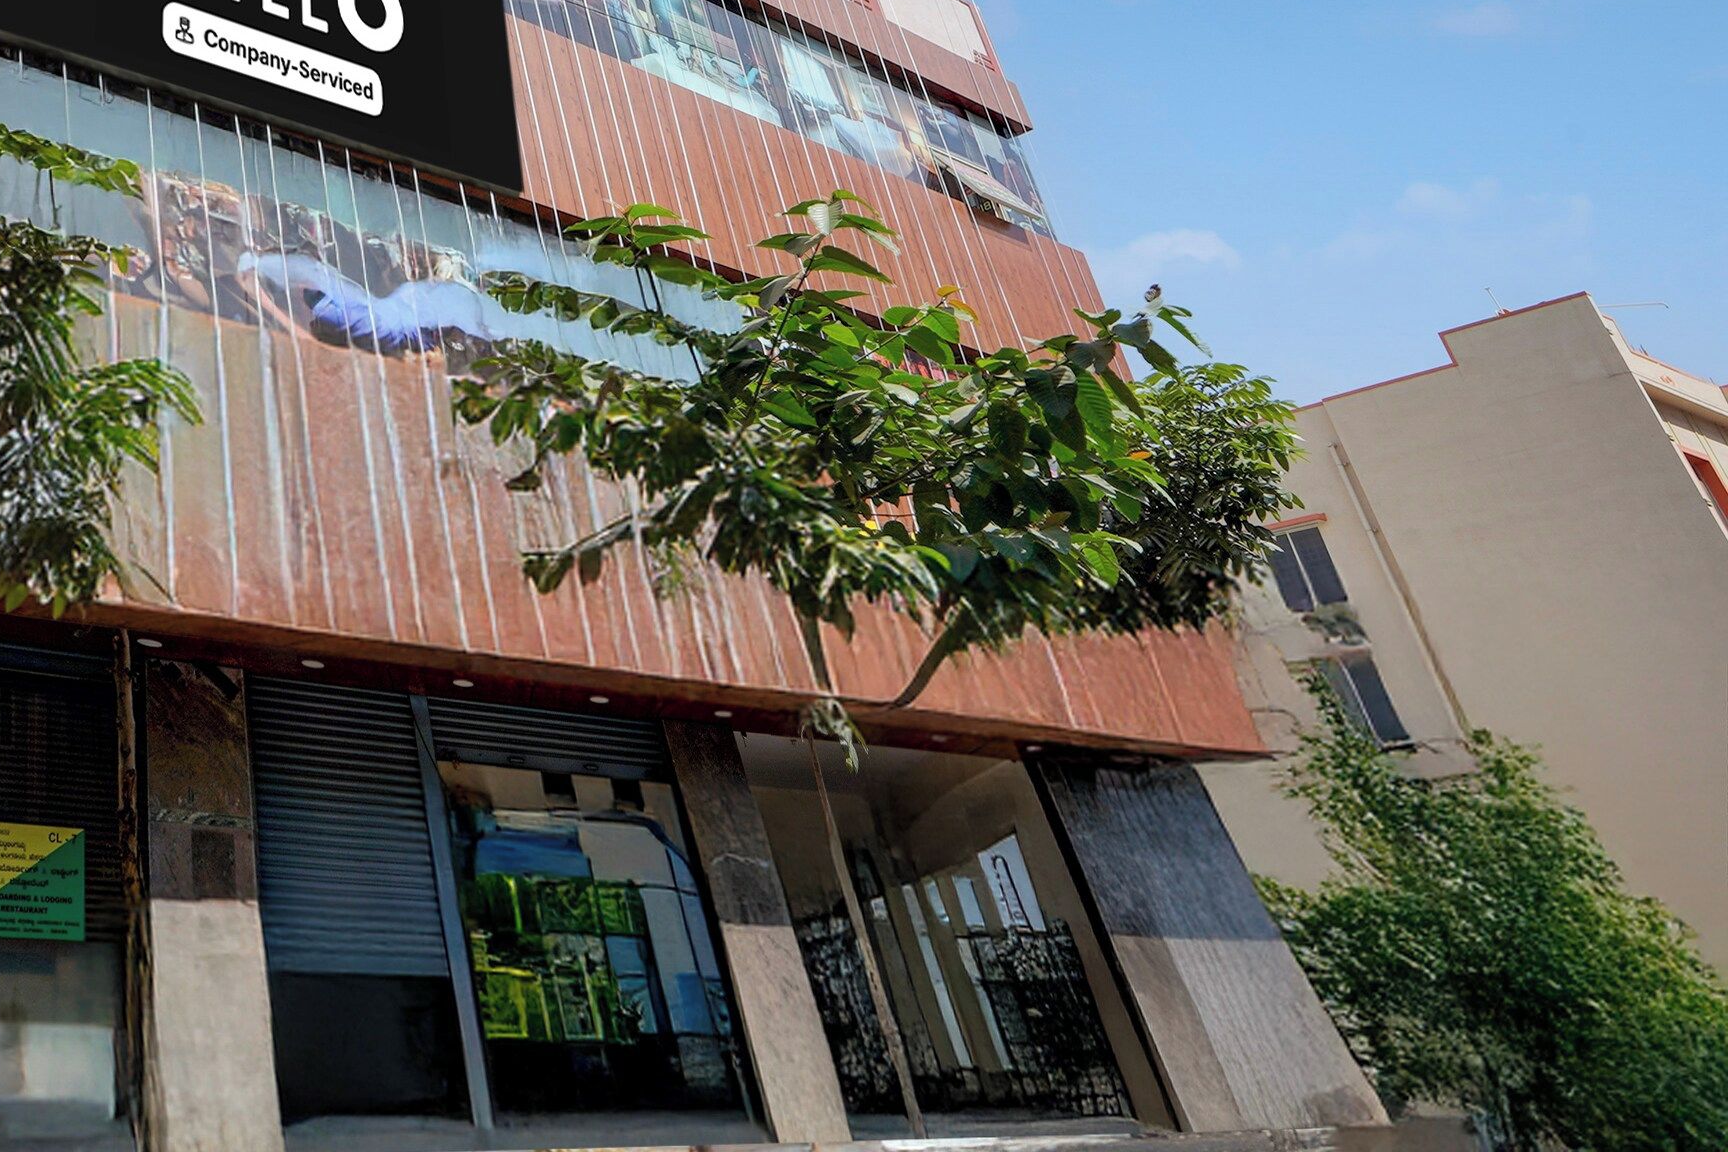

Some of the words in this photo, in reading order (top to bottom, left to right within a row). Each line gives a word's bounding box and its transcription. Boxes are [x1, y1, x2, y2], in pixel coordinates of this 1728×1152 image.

[203, 28, 374, 101] Company-Serviced
[40, 896, 73, 904] LODGING
[0, 905, 48, 914] RESTAURANT
